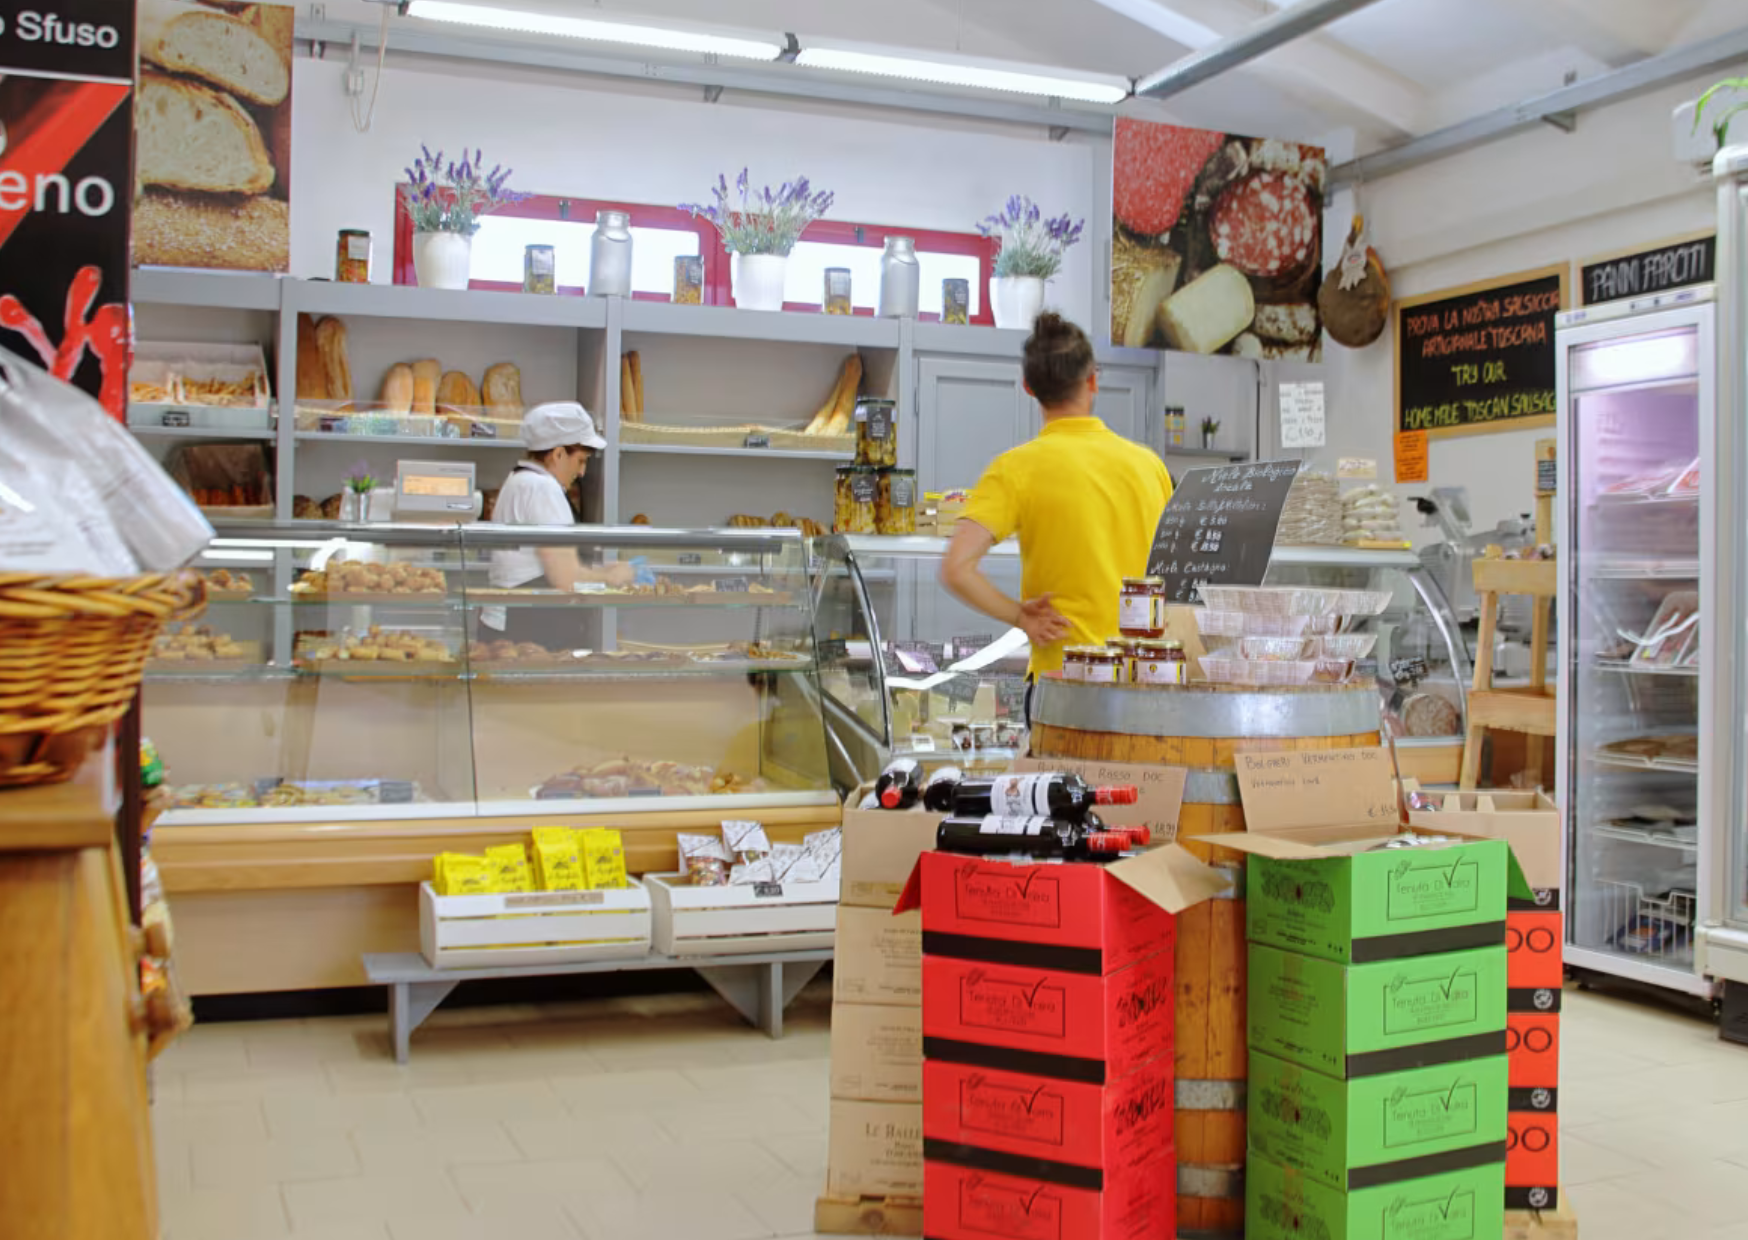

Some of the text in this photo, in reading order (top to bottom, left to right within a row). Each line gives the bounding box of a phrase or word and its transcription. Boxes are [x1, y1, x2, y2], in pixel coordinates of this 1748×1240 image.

[16, 11, 118, 48] Sfuso
[1407, 314, 1440, 338] PROVA
[1444, 309, 1459, 331] LA
[1463, 299, 1500, 326] NOSTRA
[1488, 321, 1547, 350] TOSCANA
[1451, 360, 1507, 386] TRY OUR
[1361, 751, 1378, 761] DOC
[1142, 771, 1164, 782] DOC
